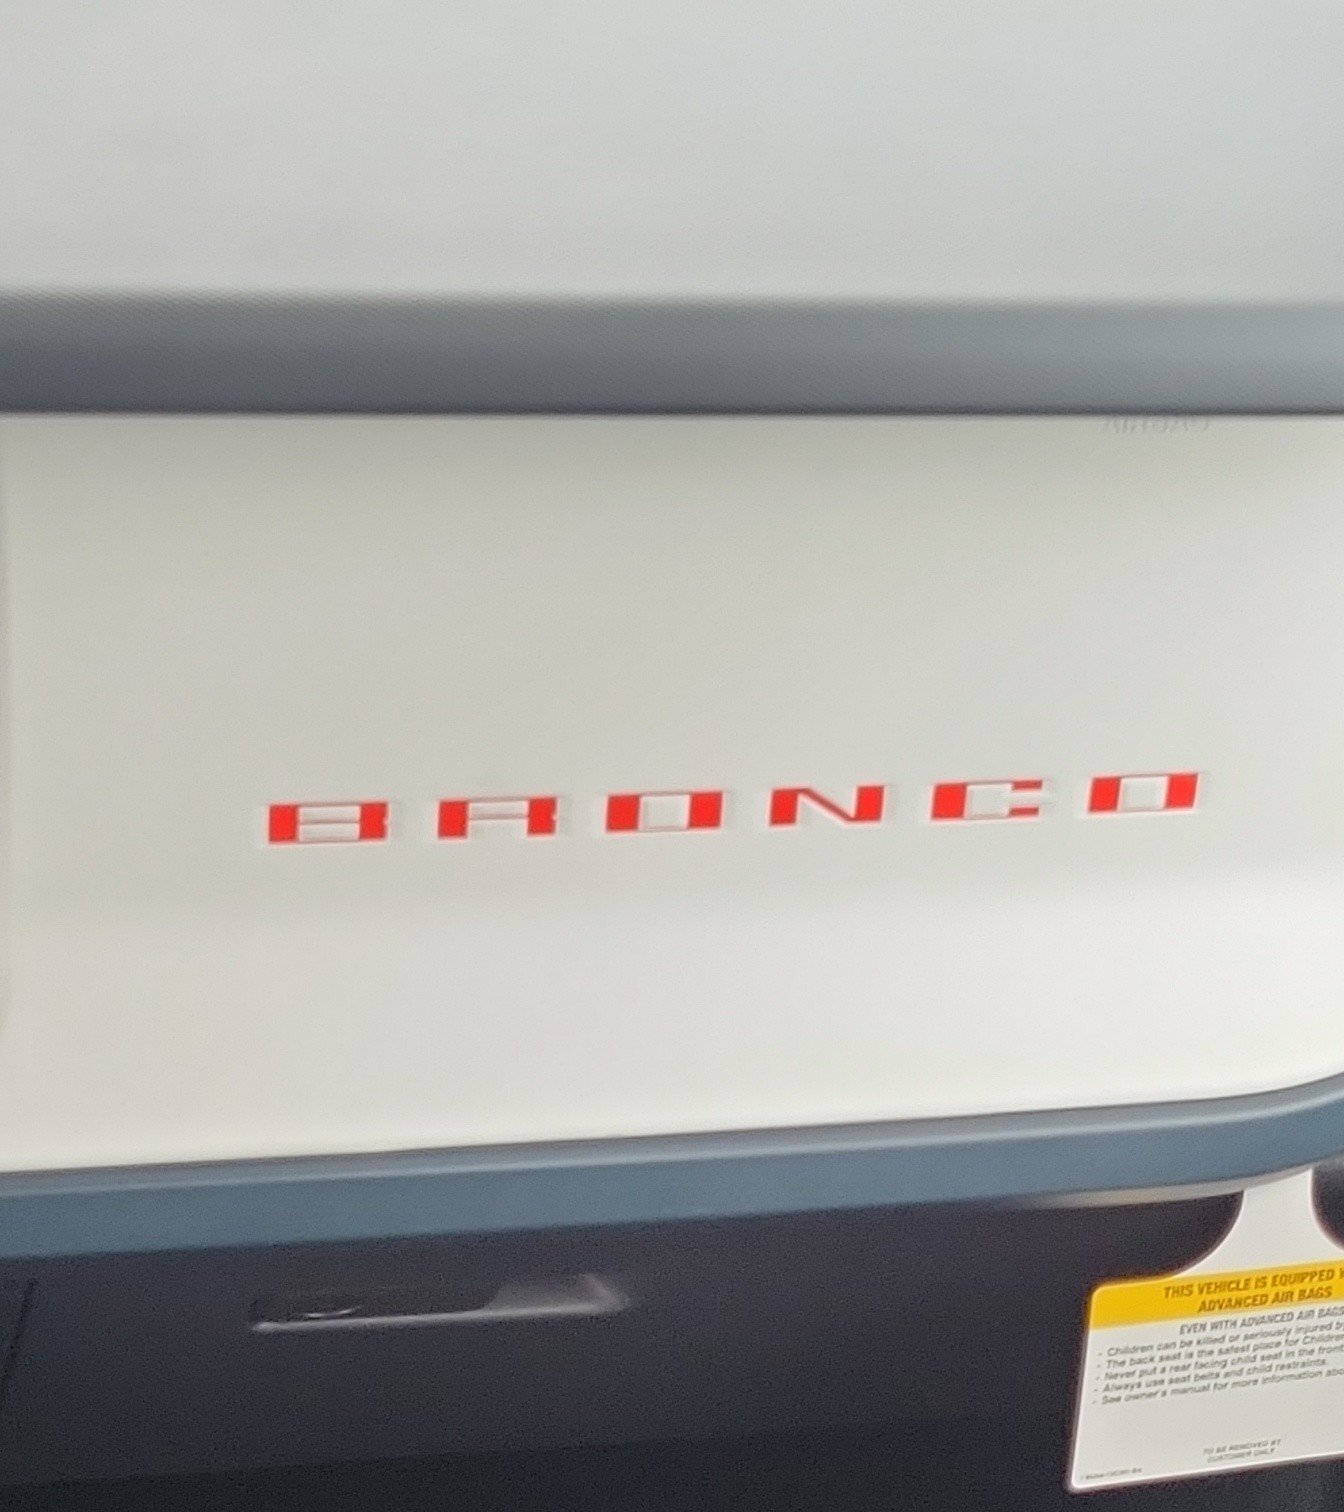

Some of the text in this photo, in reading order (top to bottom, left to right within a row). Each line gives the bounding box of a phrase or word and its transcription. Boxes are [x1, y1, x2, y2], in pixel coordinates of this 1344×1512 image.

[267, 772, 1199, 845] BRONCO
[1164, 1284, 1193, 1299] THIS
[1197, 1278, 1251, 1295] VEHICLE
[1255, 1276, 1267, 1289] IS
[1271, 1270, 1334, 1287] EQUIPPED
[1197, 1286, 1332, 1313] ADVANCED AIR BAGS
[1180, 1323, 1207, 1335] EVEN
[1210, 1319, 1237, 1331] WITH
[1240, 1312, 1294, 1328] ADVANCED
[1296, 1309, 1315, 1321] AIR
[1107, 1343, 1153, 1357] Children
[1157, 1342, 1177, 1351] can
[1179, 1339, 1193, 1348] be
[1196, 1335, 1226, 1345] killed
[1228, 1334, 1240, 1343] or
[1243, 1327, 1292, 1341] seriously
[1295, 1321, 1332, 1335] injured
[1107, 1359, 1126, 1369] The
[1129, 1355, 1155, 1366] back
[1158, 1352, 1181, 1362] seat
[1184, 1350, 1194, 1359] is
[1197, 1348, 1214, 1358] the
[1218, 1344, 1250, 1355] safest
[1252, 1340, 1282, 1352] place
[1285, 1337, 1299, 1347] for
[1103, 1381, 1142, 1393] Always
[1145, 1378, 1165, 1388] use
[1167, 1374, 1191, 1385] seat
[1194, 1370, 1220, 1382] belts
[1223, 1367, 1244, 1378] and
[1246, 1362, 1272, 1375] child
[1105, 1371, 1136, 1381] Never
[1138, 1367, 1157, 1378] put
[1169, 1362, 1192, 1372] rear
[1194, 1358, 1227, 1370] facing
[1230, 1354, 1257, 1365] child
[1260, 1350, 1282, 1361] seat
[1285, 1348, 1296, 1358] in
[1298, 1346, 1315, 1356] the
[1102, 1394, 1122, 1405] See
[1124, 1390, 1167, 1402] owner's
[1170, 1384, 1211, 1395] manual
[1213, 1382, 1228, 1391] for
[1231, 1377, 1258, 1389] more
[1261, 1370, 1323, 1385] information
